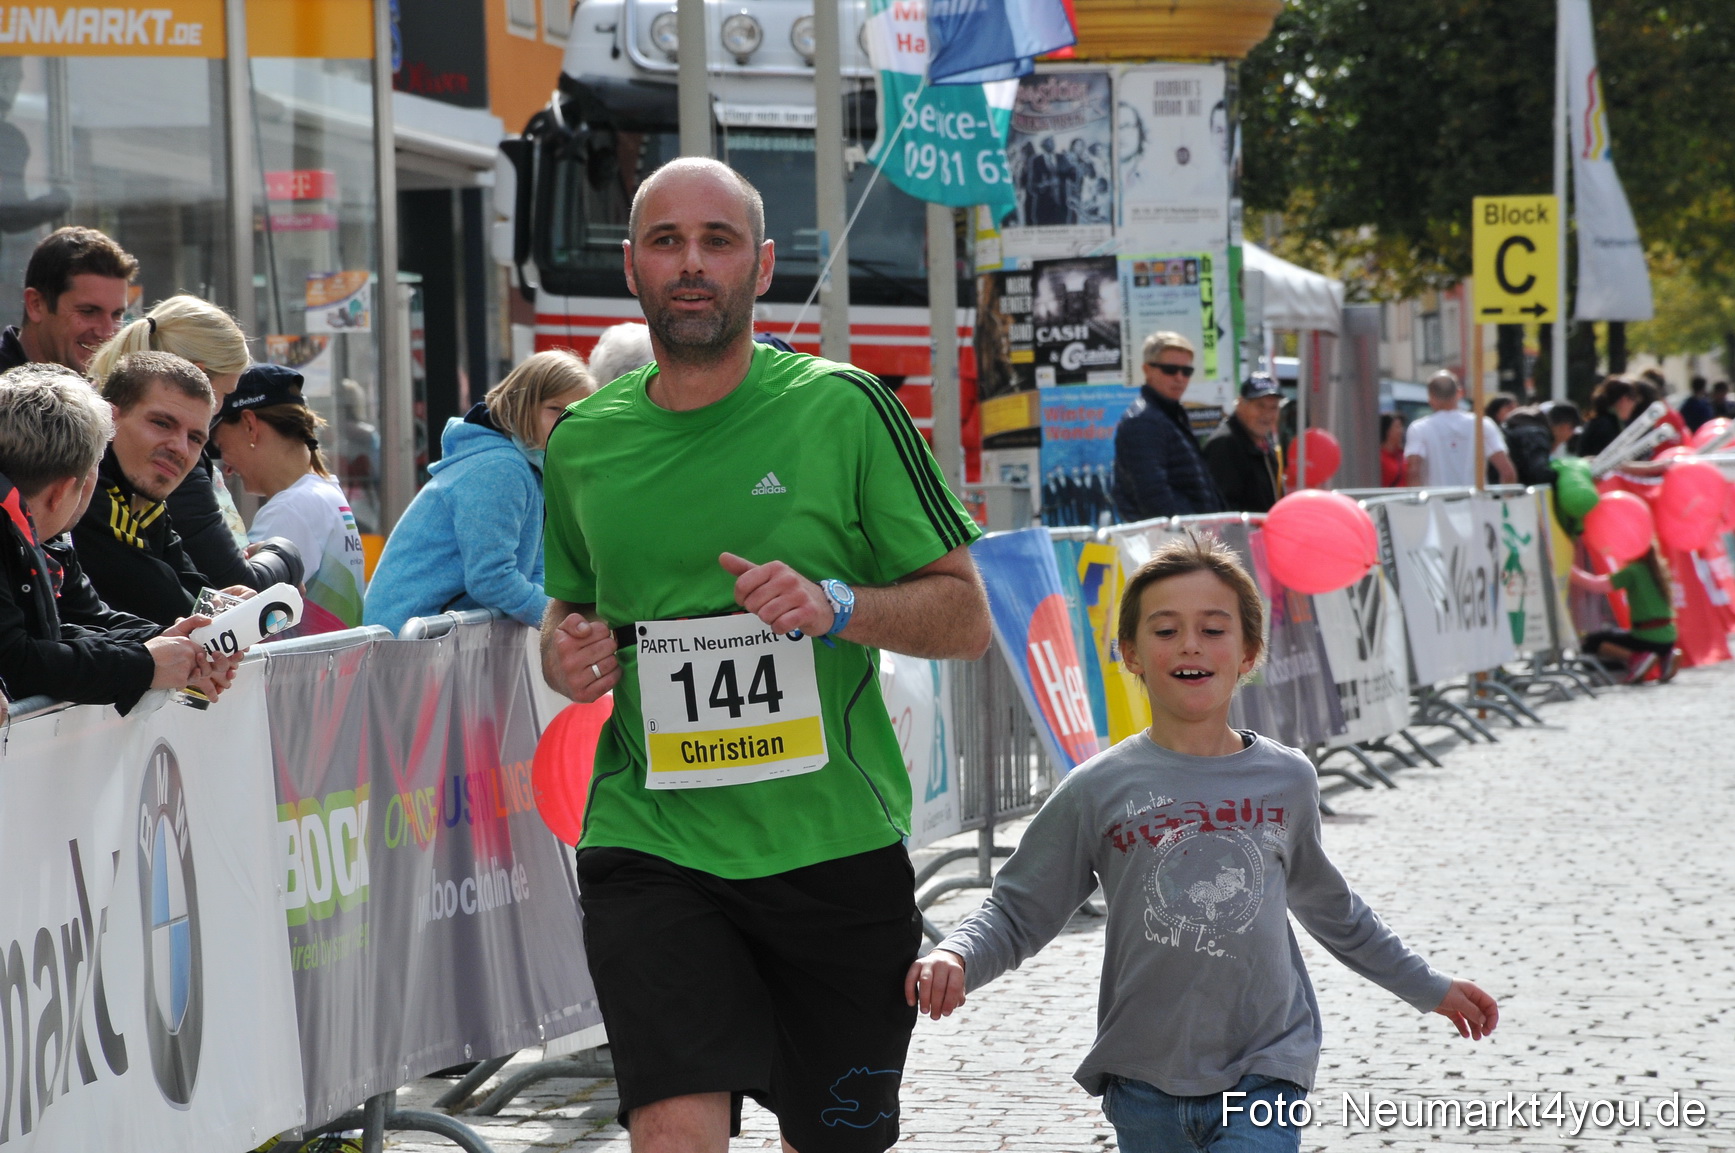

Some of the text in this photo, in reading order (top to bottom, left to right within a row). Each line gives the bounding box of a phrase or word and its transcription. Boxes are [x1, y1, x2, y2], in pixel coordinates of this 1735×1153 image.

[1484, 203, 1549, 226] Block
[1495, 235, 1537, 295] C
[1036, 325, 1089, 347] CASH
[751, 485, 787, 496] adidas
[640, 629, 779, 654] PARTL Neumarkt
[670, 654, 784, 722] 144
[680, 734, 785, 765] Christian
